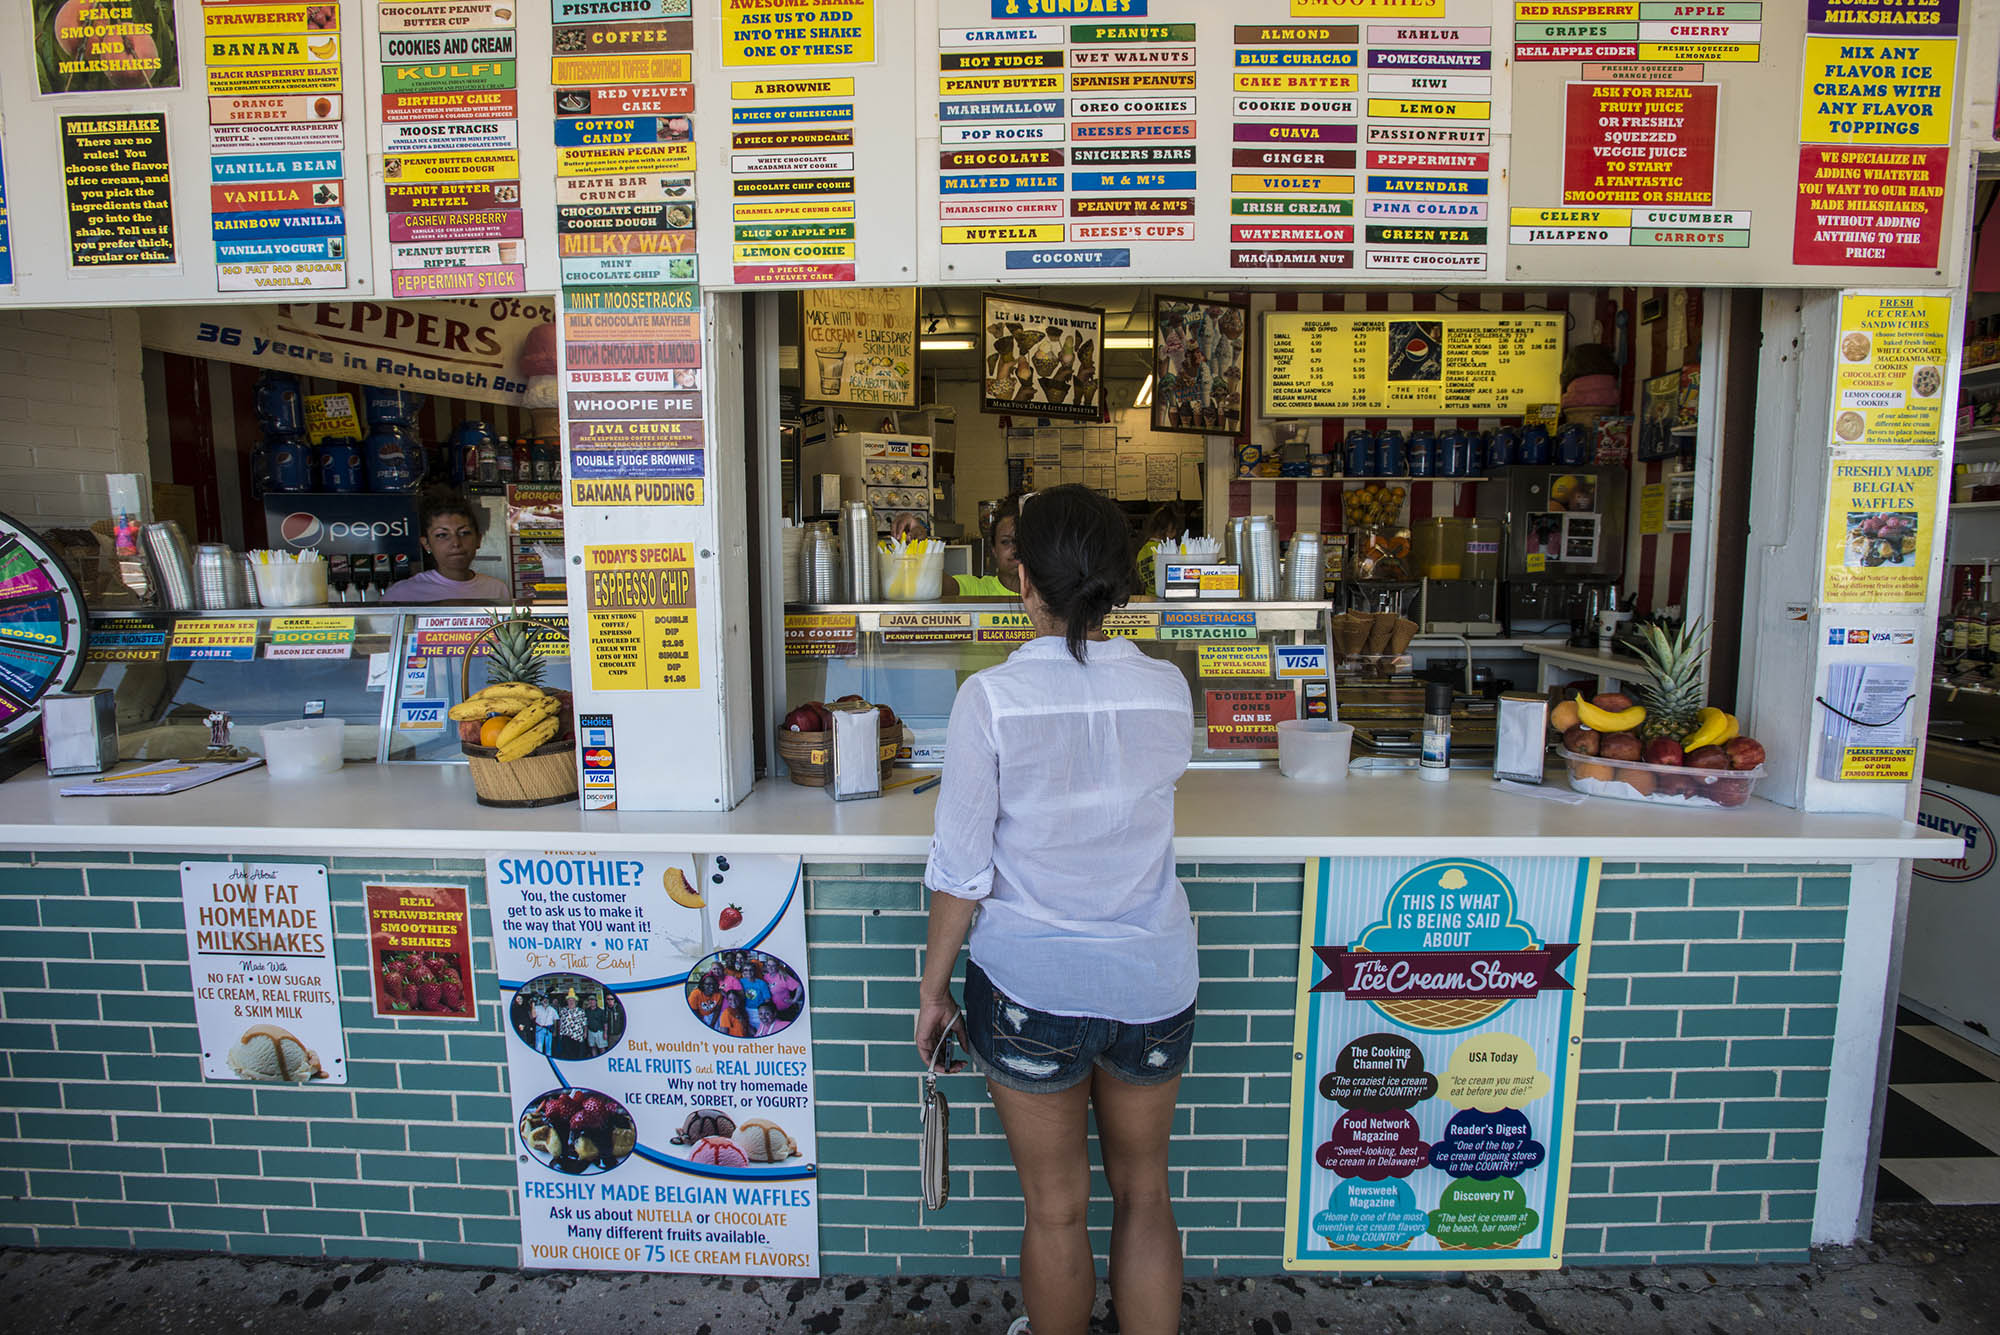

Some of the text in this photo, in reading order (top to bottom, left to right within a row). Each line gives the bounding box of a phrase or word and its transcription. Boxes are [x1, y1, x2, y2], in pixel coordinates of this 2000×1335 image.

[80, 8, 132, 20] PEACH
[206, 12, 305, 27] STRAWBERRY
[741, 11, 853, 24] ASK US TO ADD
[62, 23, 152, 38] SMOOTHIES
[592, 30, 667, 43] COFFEE
[966, 30, 1037, 41] CARAMEL
[1096, 28, 1168, 38] PEANUTS
[1261, 30, 1330, 39] ALMOND
[1397, 30, 1459, 39] KAHLUA
[1670, 25, 1729, 36] CHERRY
[92, 42, 124, 55] AND
[212, 42, 300, 57] BANANA
[388, 37, 512, 56] COOKIES AND CREAM
[1840, 47, 1919, 60] MIX ANY
[59, 57, 161, 73] MILKSHAKES
[960, 56, 1043, 67] HOT FUDGE
[1377, 55, 1480, 65] POMEGRANATE
[397, 63, 502, 80] KULFI
[1825, 65, 1932, 78] FLAVOR ICE
[1412, 79, 1447, 88] KIWI
[598, 87, 687, 99] RED VELVET
[1814, 84, 1941, 98] CREAMS WITH
[233, 100, 283, 108] ORANGE
[622, 101, 661, 111] CAKE
[946, 103, 1056, 115] MARHMALLOW
[1080, 102, 1187, 112] OREO COOKIES
[1400, 104, 1456, 114] LEMON
[230, 111, 287, 120] SHERBET
[67, 119, 159, 134] MILKSHAKE
[400, 122, 498, 135] MOOSE TRACKS
[575, 120, 635, 130] COTTON
[1829, 121, 1919, 134] TOPPINGS
[583, 133, 631, 143] CANDY
[1270, 128, 1320, 138] GUAVA
[954, 153, 1049, 164] CHOCOLATE
[1263, 154, 1325, 164] GINGER
[214, 159, 337, 175] VANILLA BEAN
[1264, 179, 1321, 188] VIOLET
[1386, 180, 1468, 192] LAVENDAR
[214, 215, 342, 230] RAINBOW VANILLA
[1540, 211, 1600, 222] CELERY
[967, 229, 1037, 239] NUTELLA
[1240, 229, 1344, 240] WATERMELON
[1655, 232, 1724, 244] CARROTS
[565, 234, 685, 253] MILKY WAY
[1032, 253, 1102, 263] COCONUT
[398, 271, 515, 291] PEPPERMINT STICK
[571, 292, 692, 308] MINT MOOSETRACKS
[1887, 310, 1926, 318] CREAM
[996, 311, 1011, 320] LET
[1014, 314, 1026, 322] US
[1048, 317, 1068, 326] YOUR
[1071, 319, 1097, 330] WAFFLE
[197, 323, 488, 387] 36 years in Rehoboth
[572, 372, 668, 383] BUBBLE GUM
[574, 399, 692, 411] WHOOPIE PIE
[590, 424, 681, 436] JAVA CHUNK
[1837, 466, 1933, 478] FRESHLY MADE
[577, 484, 694, 502] BANANA PUDDING
[1853, 481, 1914, 494] BELGIAN
[1852, 497, 1914, 509] WAFFLES
[329, 517, 408, 547] pepsi
[592, 547, 686, 564] TODAY'S SPECIAL
[594, 570, 689, 607] ESPRESSO CHIP
[890, 616, 961, 624] JAVA CHUNK
[1167, 613, 1253, 623] MOOSETRACKS
[174, 634, 255, 644] CAKE BATTER
[275, 632, 349, 642] BOOGER
[1171, 628, 1247, 638] PISTACHIO
[1286, 656, 1319, 668] VISA
[407, 710, 438, 720] VISA
[500, 859, 644, 886] SMOOTHIE?
[213, 883, 298, 904] LOW FAT
[400, 898, 434, 907] REAL
[1403, 894, 1499, 909] THIS IS WHAT
[200, 907, 317, 929] HOMEMADE
[373, 910, 463, 921] STRAWBERRY
[1398, 913, 1500, 928] IS BEING SAID
[381, 923, 457, 935] SMOOTHIES
[197, 930, 325, 953] MILKSHAKES
[389, 937, 451, 948] & SHAKES
[1423, 932, 1471, 947] ABOUT
[1366, 960, 1387, 973] The
[1348, 960, 1537, 992] Ice Cream Store
[1469, 1052, 1518, 1063] USA Today
[1343, 1119, 1409, 1129] Food Network
[1451, 1124, 1527, 1136] Reader's Digest
[1353, 1130, 1399, 1142] Magazine
[525, 1181, 810, 1207] FRESHLY MADE BELGIAN WAFFLES
[1454, 1191, 1514, 1201] Discovery TV
[531, 1245, 810, 1267] YOUR CHOICE OF 75 ICE CREAM FLAVORS!
